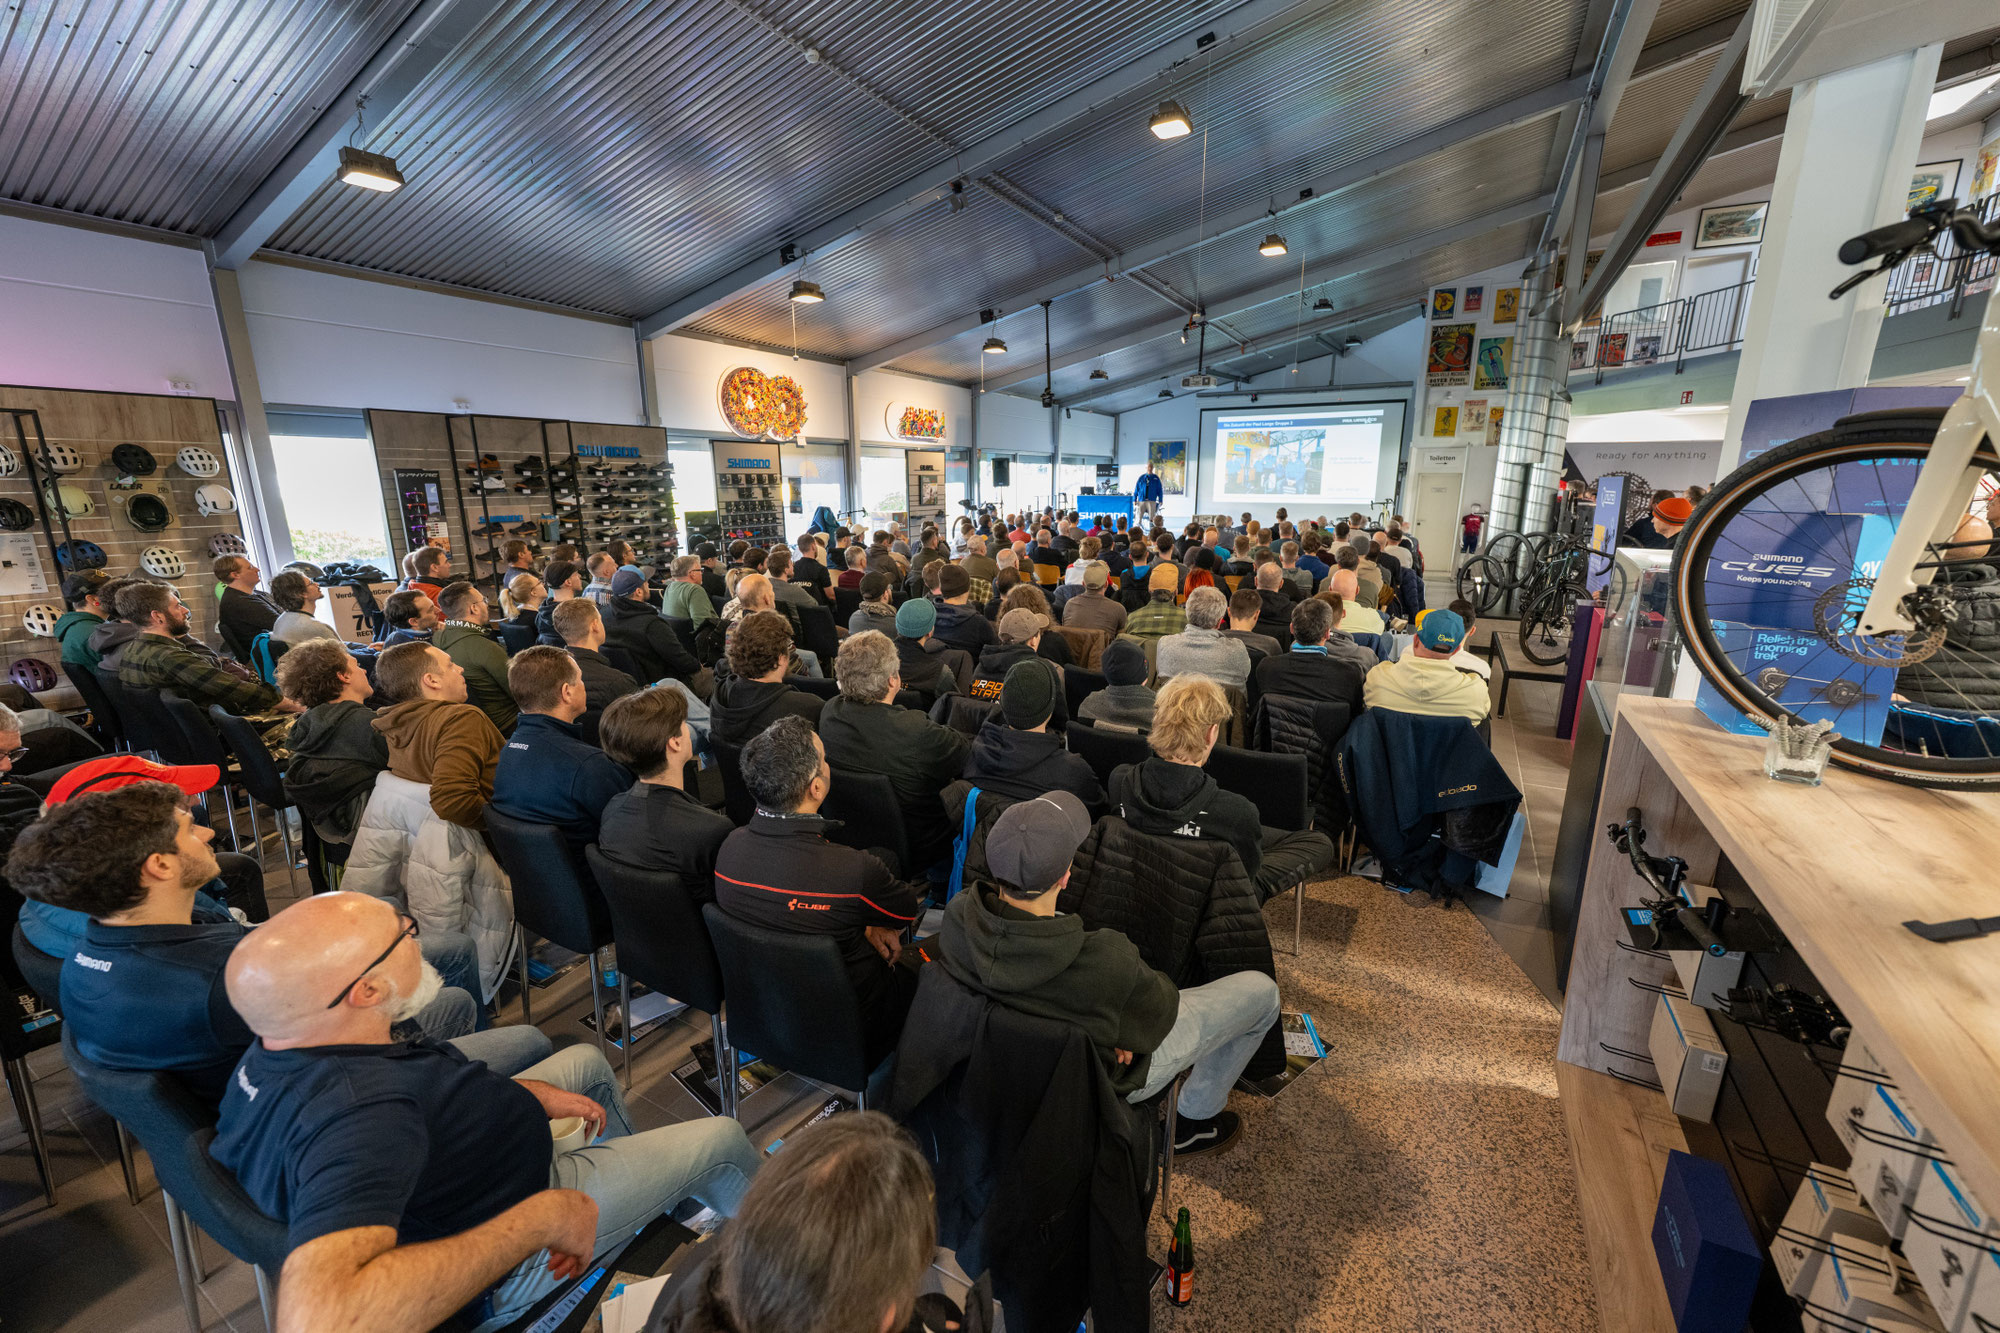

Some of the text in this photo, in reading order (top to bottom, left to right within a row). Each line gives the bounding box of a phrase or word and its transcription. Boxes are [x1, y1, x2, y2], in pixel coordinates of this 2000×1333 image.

[577, 445, 639, 457] SHIMANO
[1596, 452, 1626, 460] Ready
[1631, 452, 1649, 460] for
[727, 458, 771, 468] SHIMANO
[1752, 553, 1803, 563] SHIMANO
[1721, 561, 1836, 578] CUES
[1737, 574, 1812, 588] Keeps you moving
[1757, 633, 1818, 646] Relish the
[1755, 643, 1808, 656] morning
[797, 902, 831, 911] CUBE
[74, 952, 112, 973] SHIMANO
